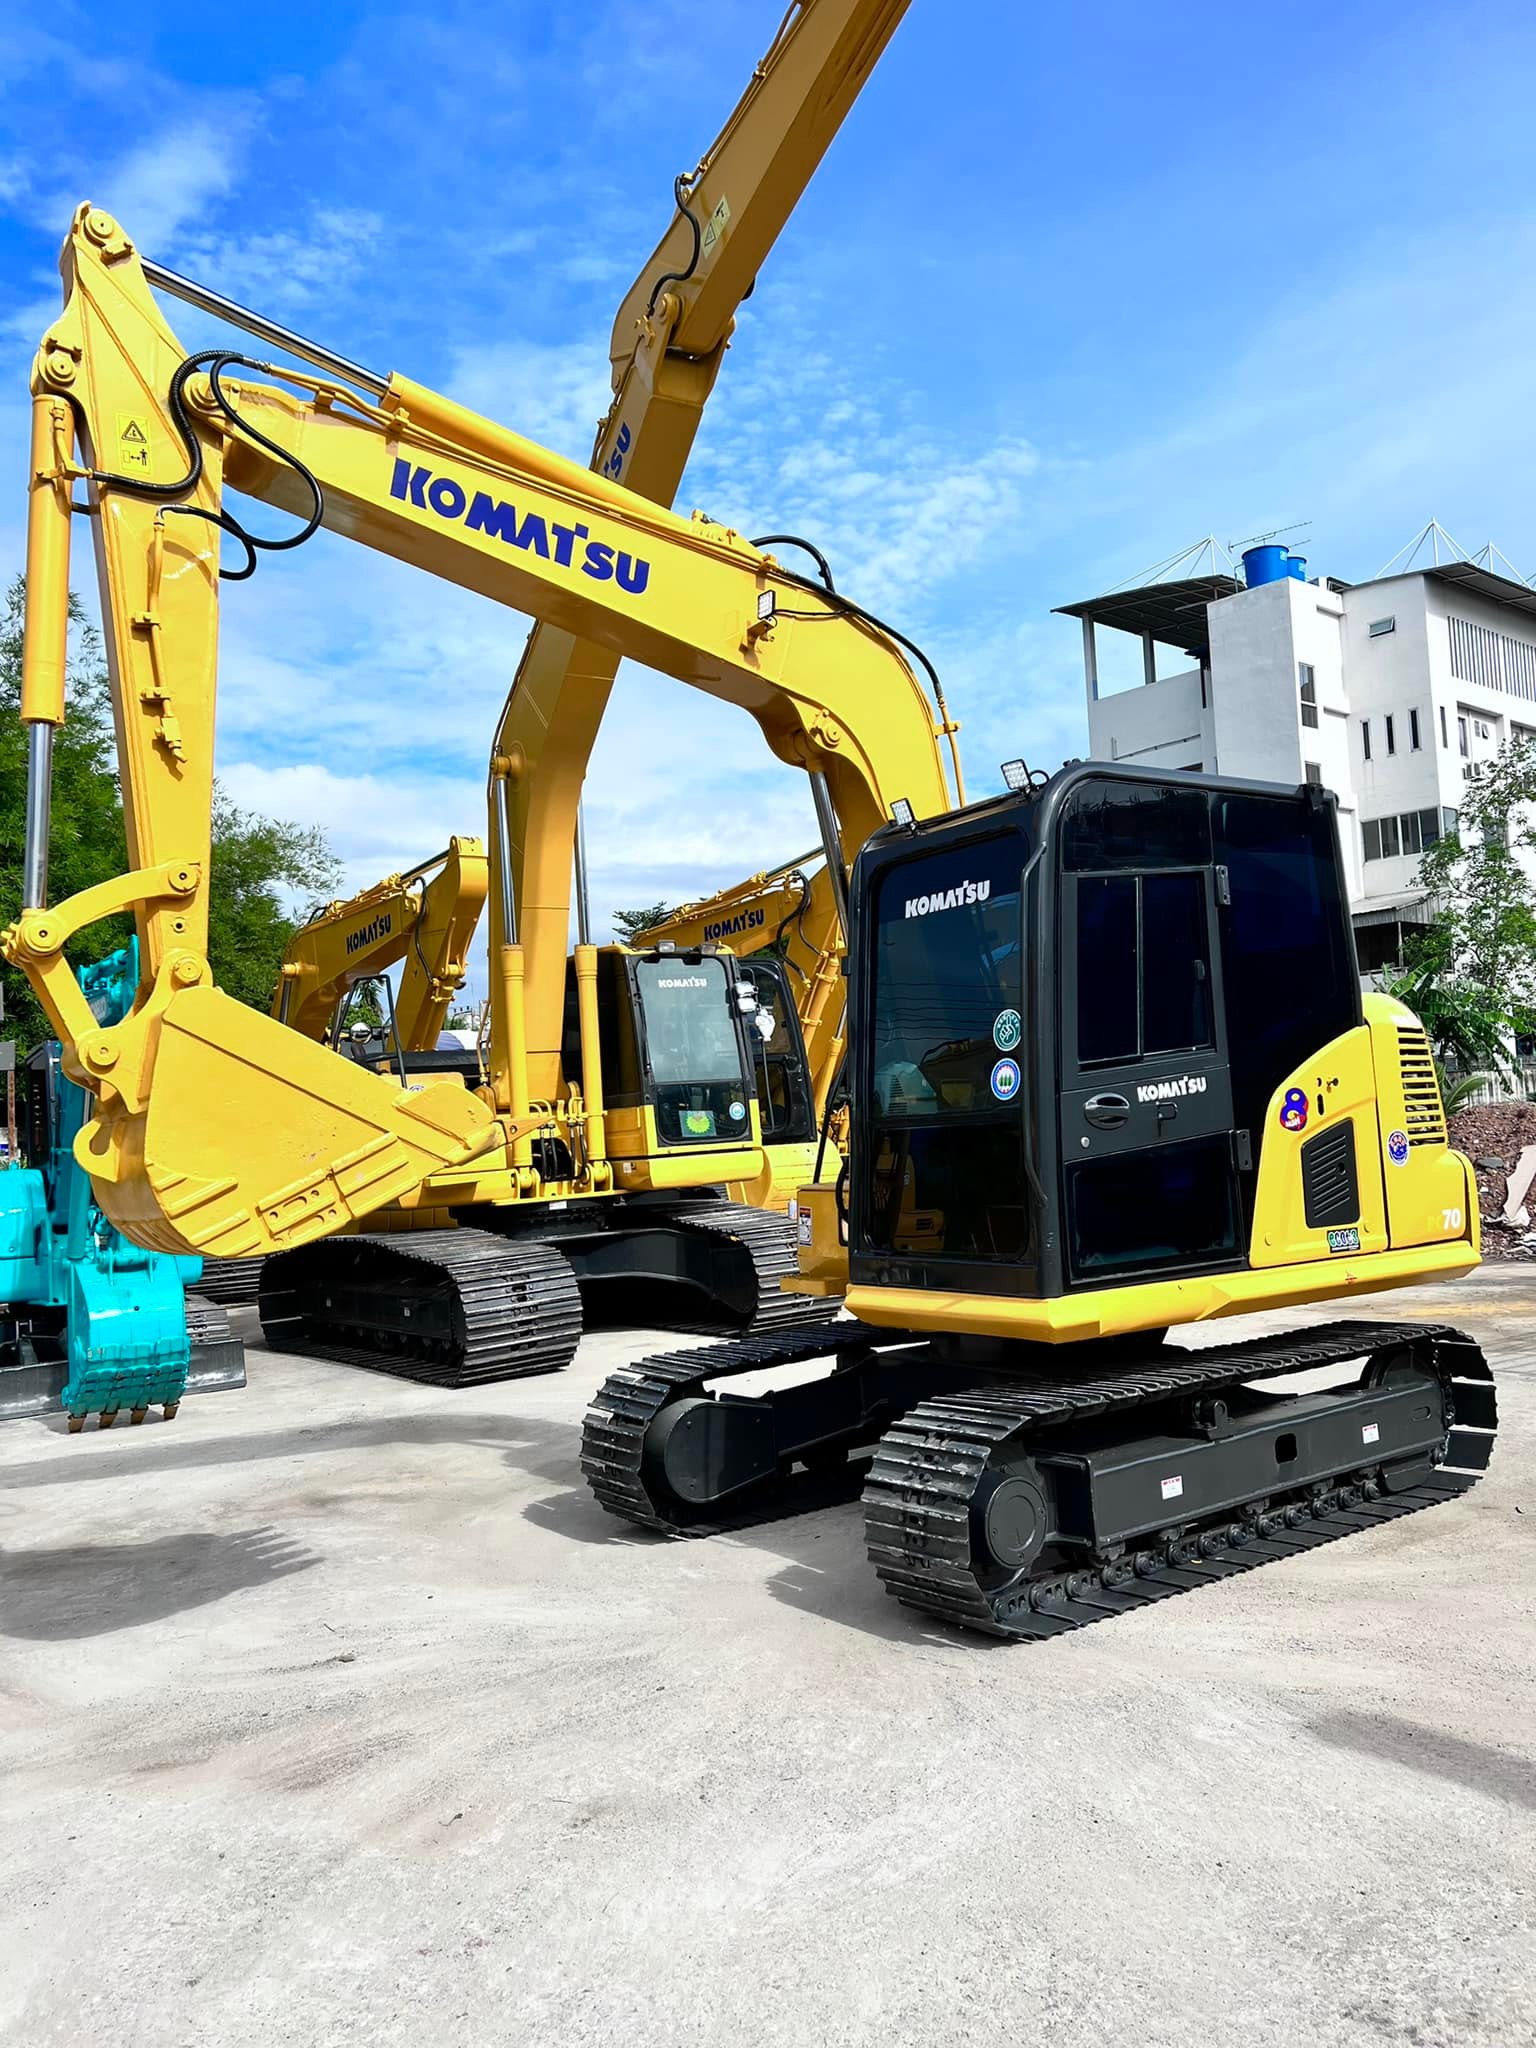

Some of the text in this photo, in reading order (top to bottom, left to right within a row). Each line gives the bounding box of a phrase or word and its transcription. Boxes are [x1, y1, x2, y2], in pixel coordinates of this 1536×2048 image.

[390, 457, 650, 594] KOMATSU
[904, 879, 991, 919] KOMATSU
[346, 913, 392, 955] KOMATSU
[704, 909, 764, 942] KOMATSU
[658, 976, 708, 988] KOMATSU
[1137, 1076, 1207, 1102] KOMATSU
